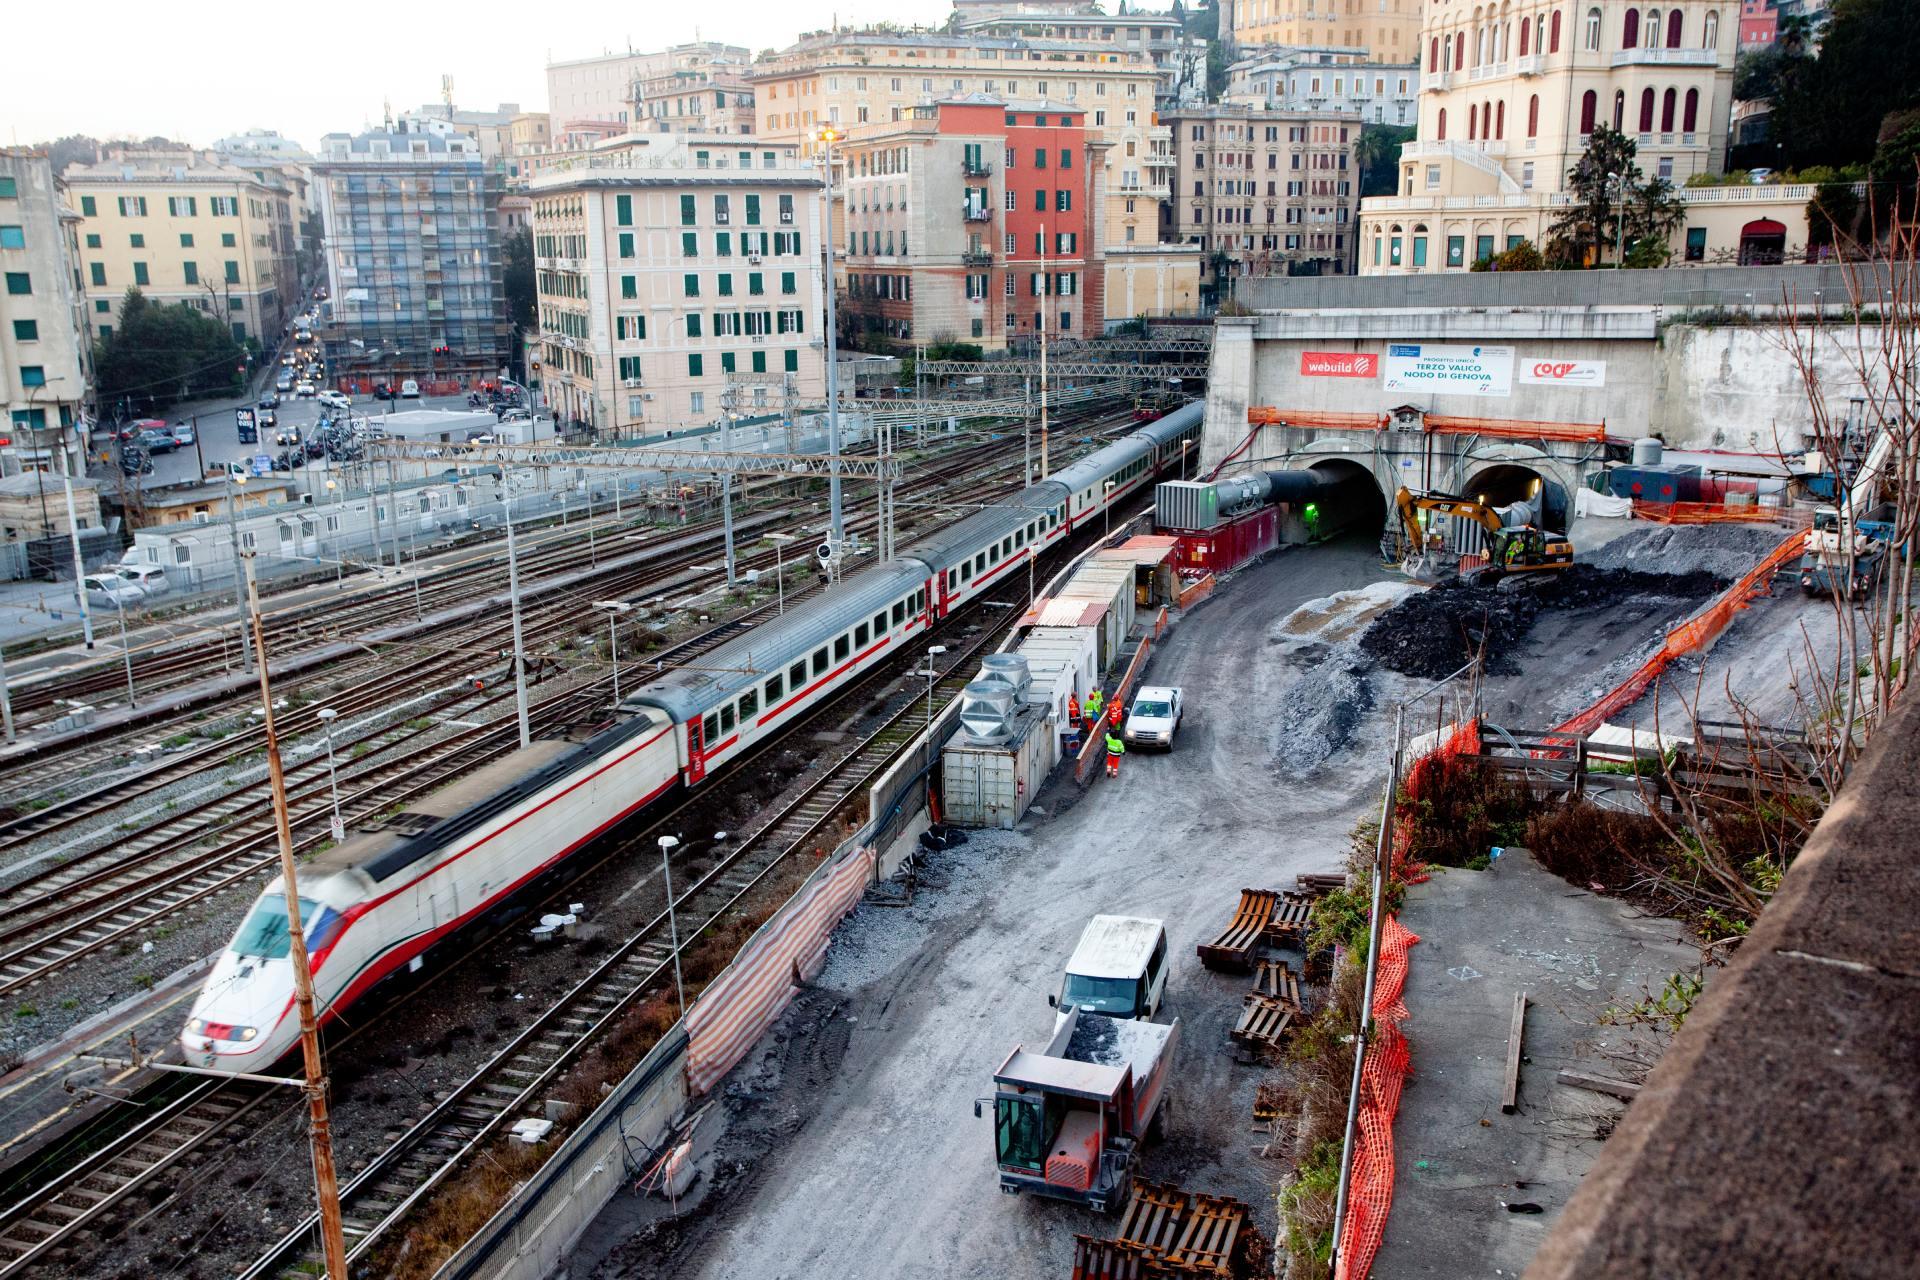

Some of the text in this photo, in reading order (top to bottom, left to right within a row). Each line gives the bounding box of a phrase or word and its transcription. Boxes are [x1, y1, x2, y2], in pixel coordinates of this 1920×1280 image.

[1309, 361, 1352, 373] webuild
[1416, 363, 1482, 372] TERZO VALICO
[1449, 373, 1492, 381] GENOVA
[238, 420, 254, 429] easy
[1440, 503, 1450, 511] CAT
